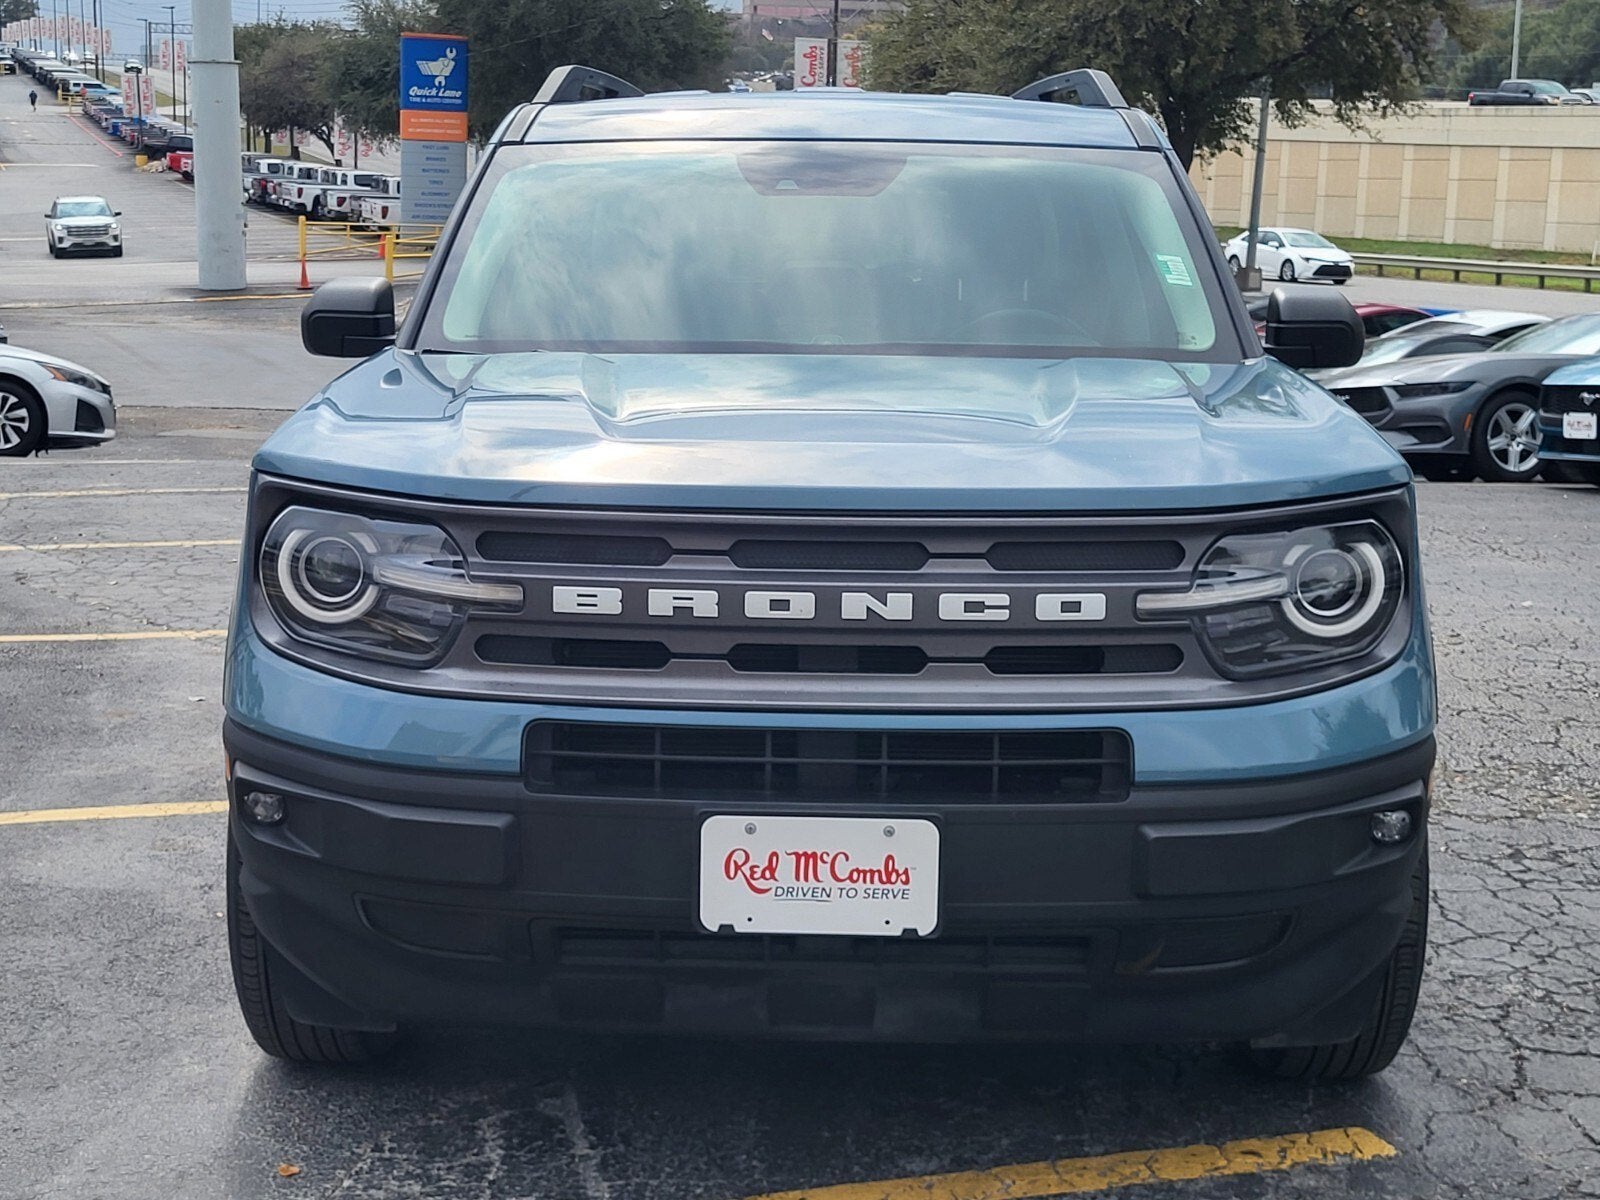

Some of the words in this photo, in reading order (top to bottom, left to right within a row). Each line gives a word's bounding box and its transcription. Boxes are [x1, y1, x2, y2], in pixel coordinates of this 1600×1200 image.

[408, 86, 439, 97] Quick
[438, 88, 462, 98] Lane
[552, 585, 1107, 622] BRONCO
[723, 848, 780, 895] Red
[785, 850, 911, 886] McCombs
[773, 886, 832, 899] DRIVEN
[837, 887, 859, 899] TO
[863, 888, 911, 900] SERVE
